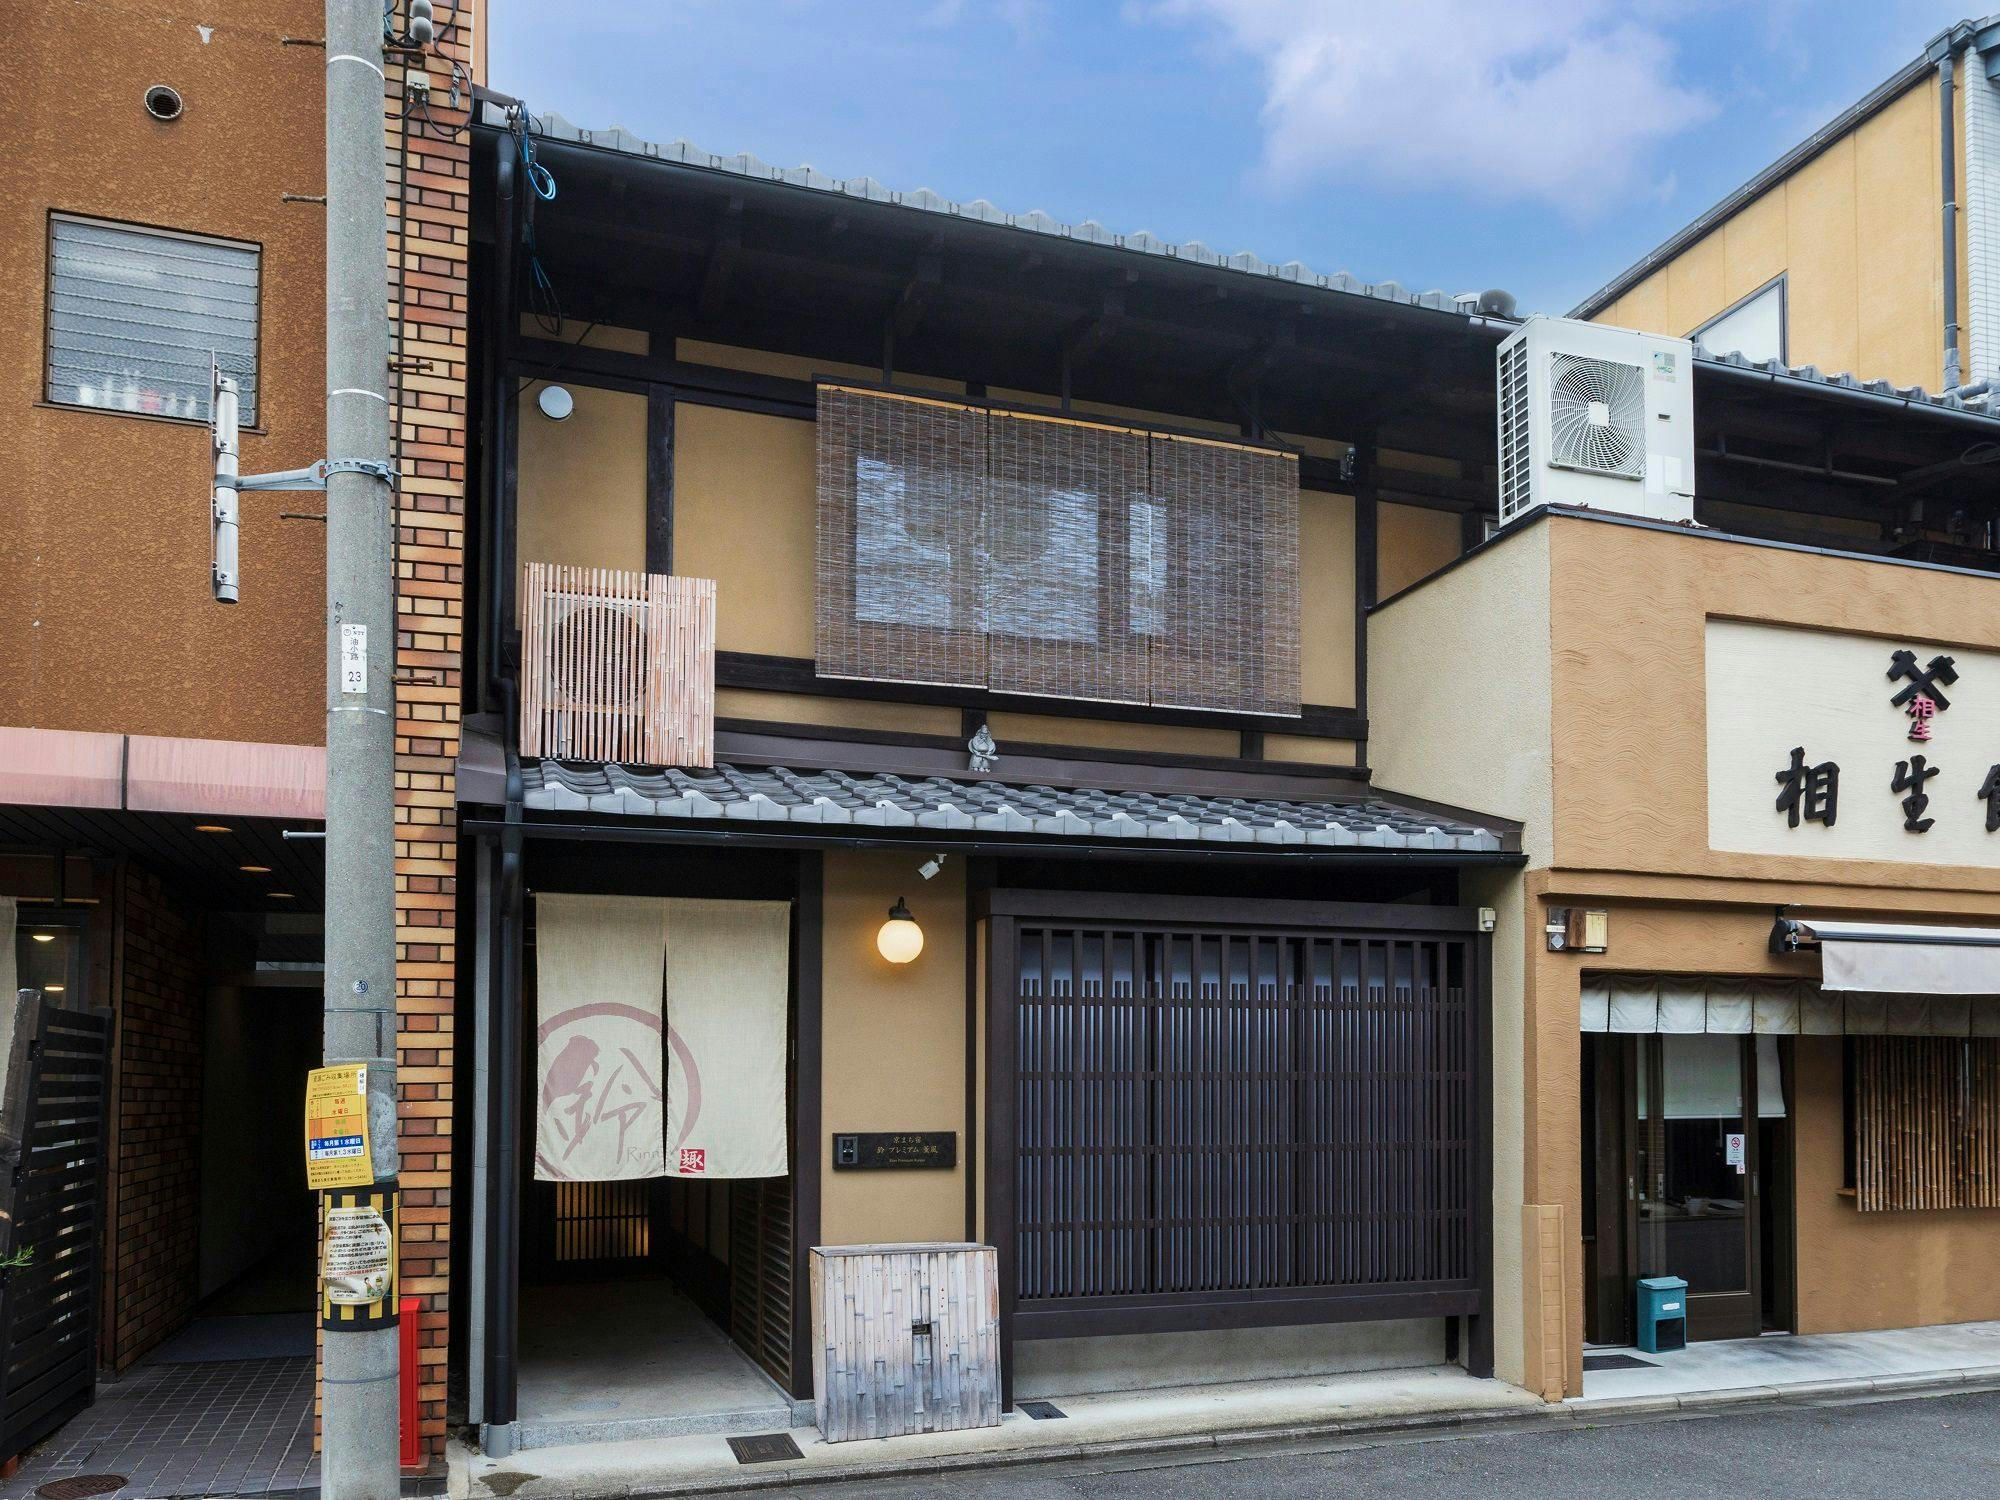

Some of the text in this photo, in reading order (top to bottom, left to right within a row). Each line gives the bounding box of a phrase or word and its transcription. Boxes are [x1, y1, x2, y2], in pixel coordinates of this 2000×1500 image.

[350, 638, 359, 661] 油小路
[348, 671, 362, 682] 23
[1908, 695, 1935, 742] 相生
[356, 983, 366, 991] 20
[889, 1146, 919, 1154] プレミアム
